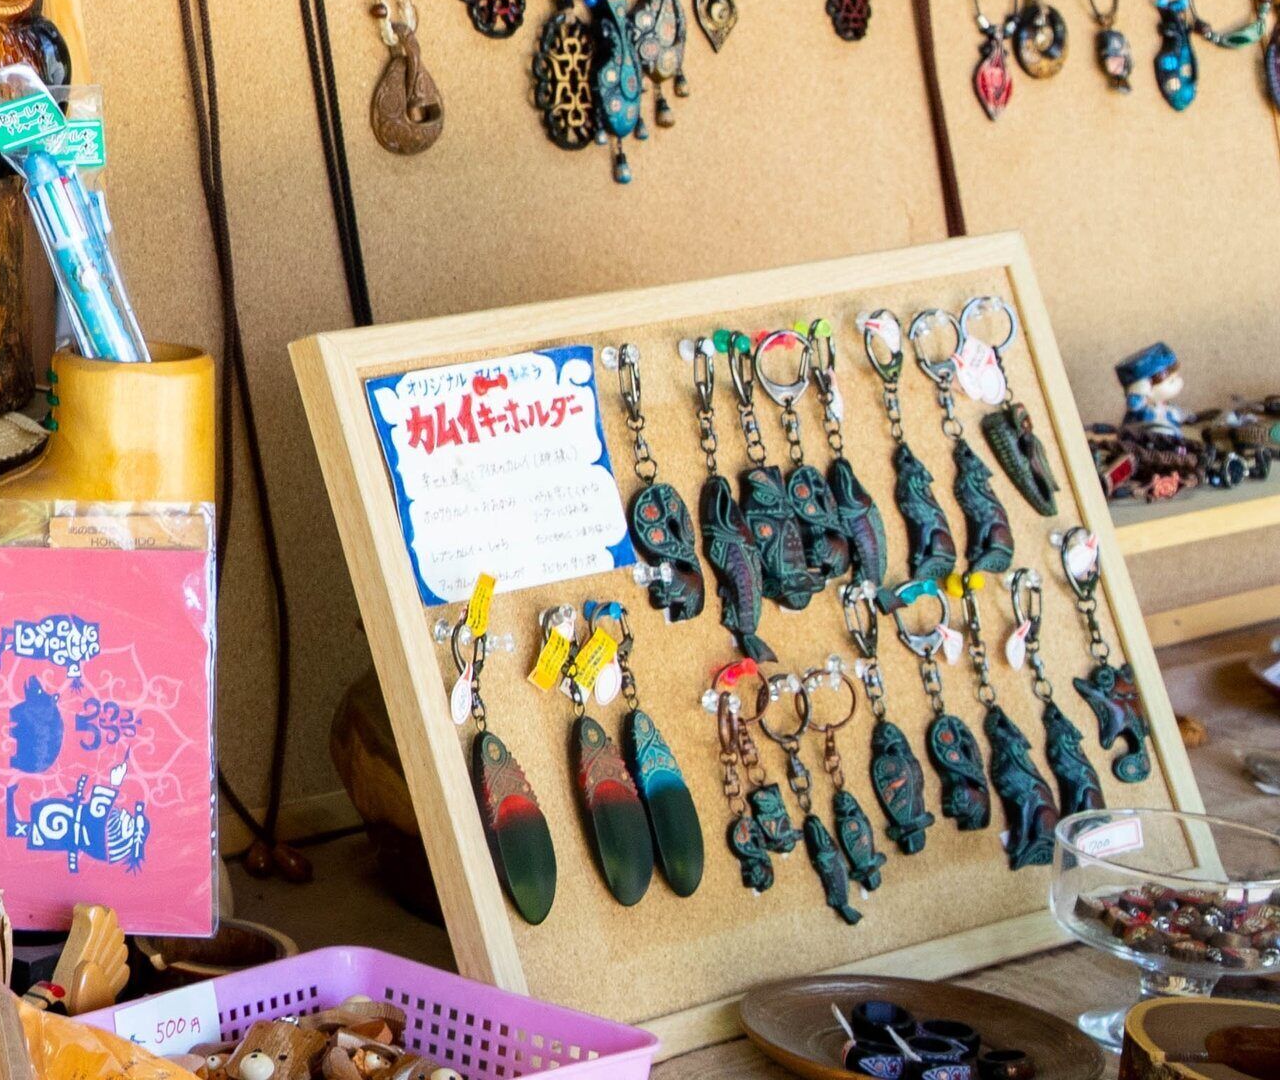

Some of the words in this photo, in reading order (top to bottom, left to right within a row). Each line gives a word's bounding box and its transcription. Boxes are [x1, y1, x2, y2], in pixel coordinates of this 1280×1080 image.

[405, 393, 583, 455] カムイキーホルダー
